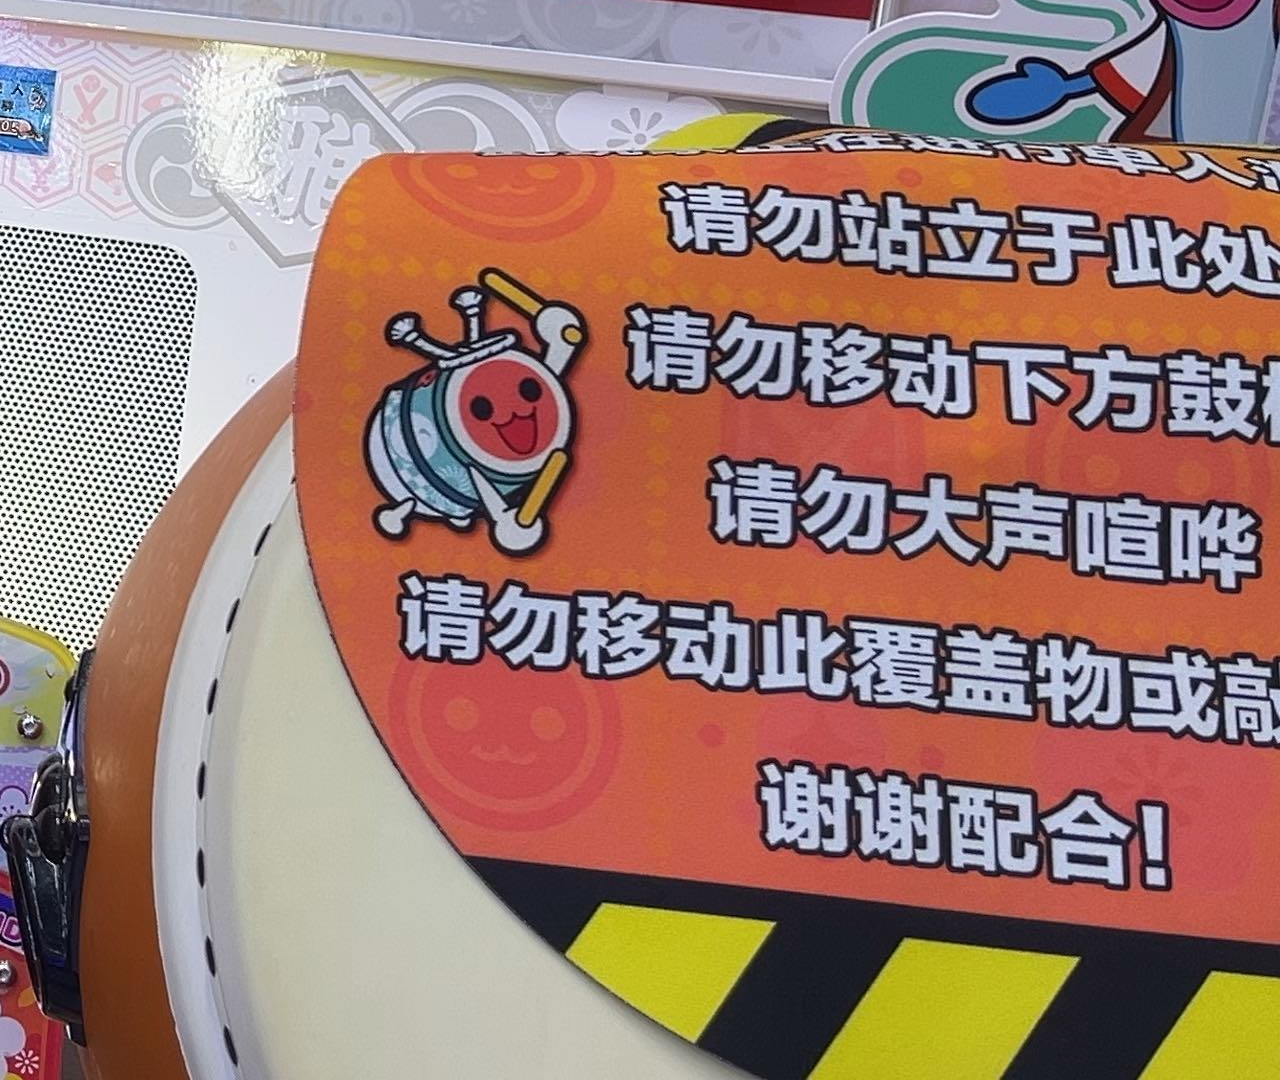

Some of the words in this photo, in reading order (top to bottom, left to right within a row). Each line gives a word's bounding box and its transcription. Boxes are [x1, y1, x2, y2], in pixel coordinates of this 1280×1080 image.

[664, 183, 1280, 297] 请勿站立于此处
[627, 306, 1280, 445] 请勿移动下方鼓
[709, 457, 1261, 590] 请勿大声喧哗
[759, 763, 1170, 888] 谢谢配合！
